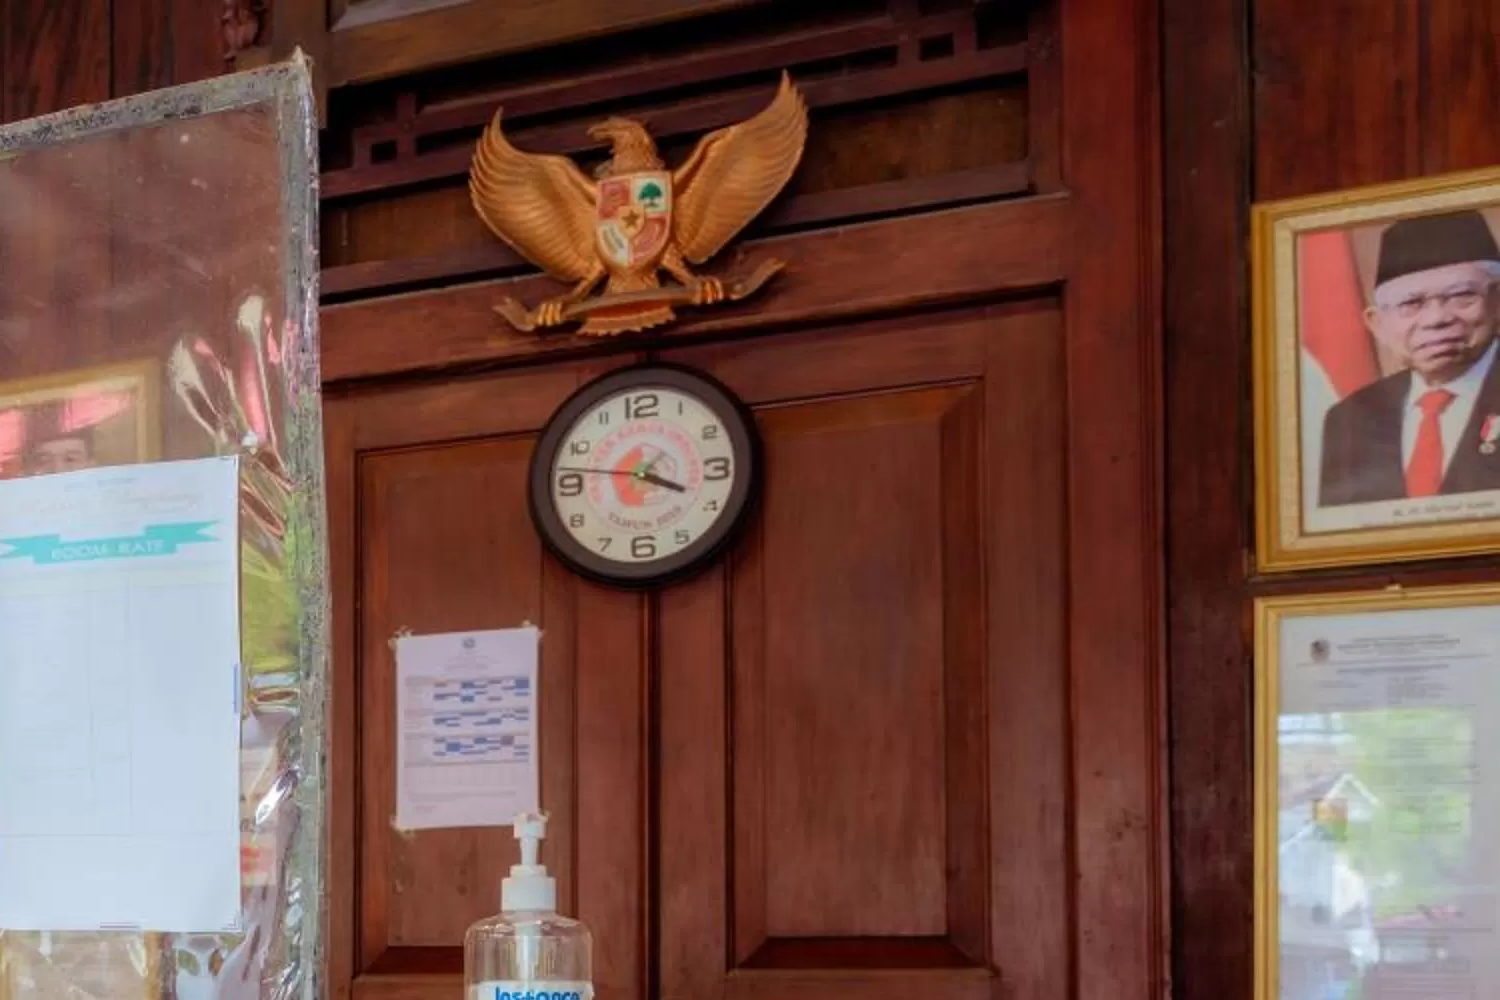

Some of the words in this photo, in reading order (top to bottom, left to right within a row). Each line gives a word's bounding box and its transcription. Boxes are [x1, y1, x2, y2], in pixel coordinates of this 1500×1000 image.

[624, 394, 659, 420] 12
[678, 401, 683, 416] 1
[599, 412, 609, 425] 11
[702, 424, 718, 440] 2
[570, 440, 590, 456] 10
[703, 457, 730, 481] 3
[558, 473, 583, 497] 9
[702, 500, 718, 512] 4
[569, 513, 585, 528] 8
[674, 529, 690, 544] 5
[596, 537, 613, 552] 7
[630, 535, 657, 559] 6
